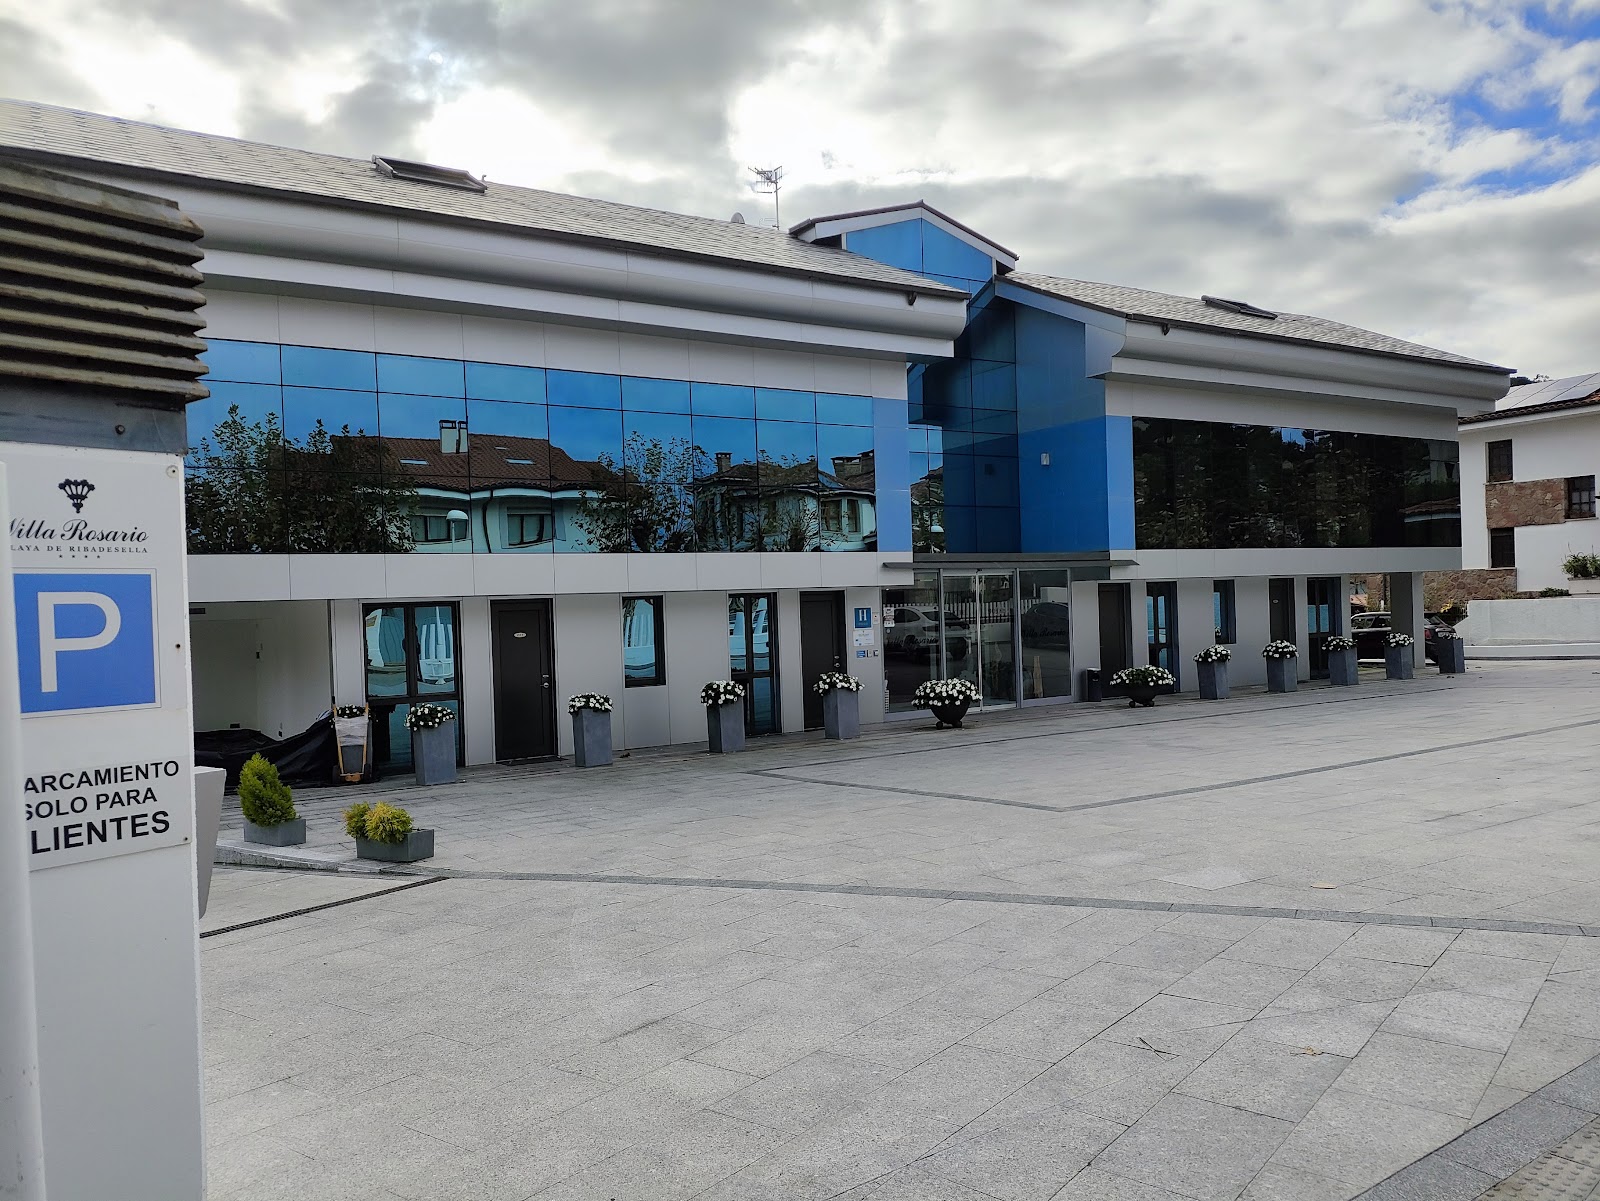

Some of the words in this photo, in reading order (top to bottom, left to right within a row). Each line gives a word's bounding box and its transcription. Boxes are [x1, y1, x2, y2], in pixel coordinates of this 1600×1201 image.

[9, 517, 57, 539] Villa
[60, 518, 149, 543] Rosario
[10, 544, 40, 552] LAYA
[69, 545, 148, 554] RIBADESELLA
[858, 609, 868, 622] H
[37, 591, 122, 693] P
[24, 760, 180, 795] ARCAMIENTO
[25, 796, 88, 821] SOLO
[96, 787, 158, 811] PARA
[31, 810, 171, 855] LIENTES
